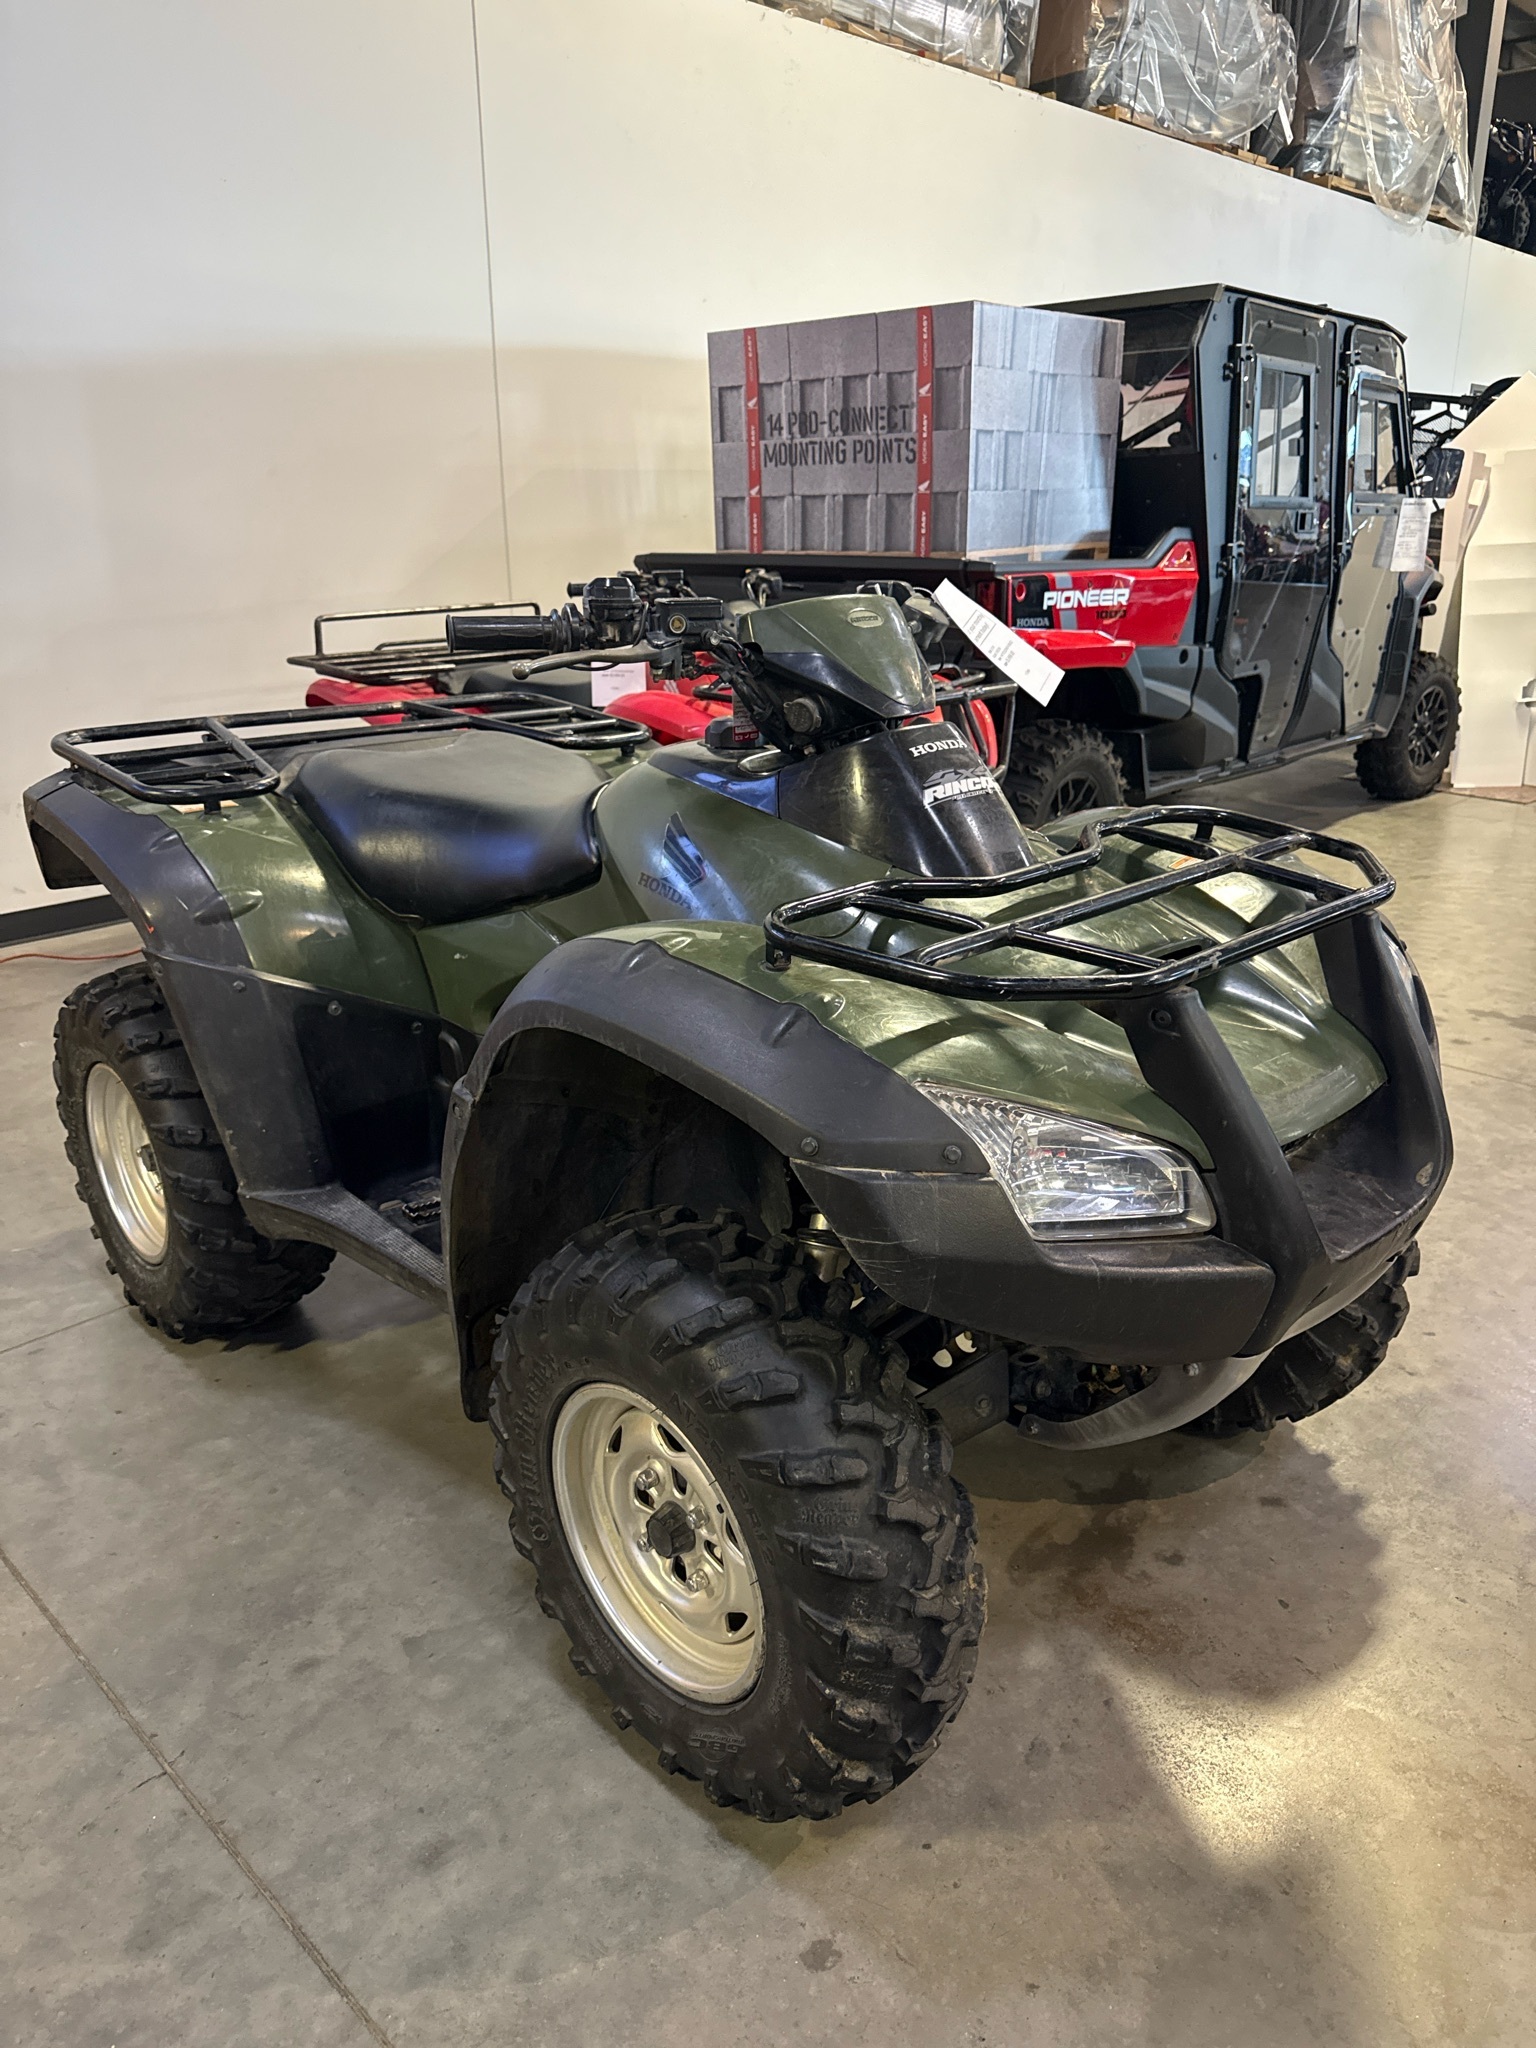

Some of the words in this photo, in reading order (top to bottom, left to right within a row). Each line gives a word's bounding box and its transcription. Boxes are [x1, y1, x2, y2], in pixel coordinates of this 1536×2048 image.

[766, 413, 784, 437] 14
[763, 438, 847, 468] MOUNTING
[852, 436, 917, 465] POINTS
[1042, 588, 1130, 611] PIONEER
[1016, 617, 1050, 628] HONDA
[908, 740, 968, 757] HONDA
[637, 871, 693, 913] HONDA
